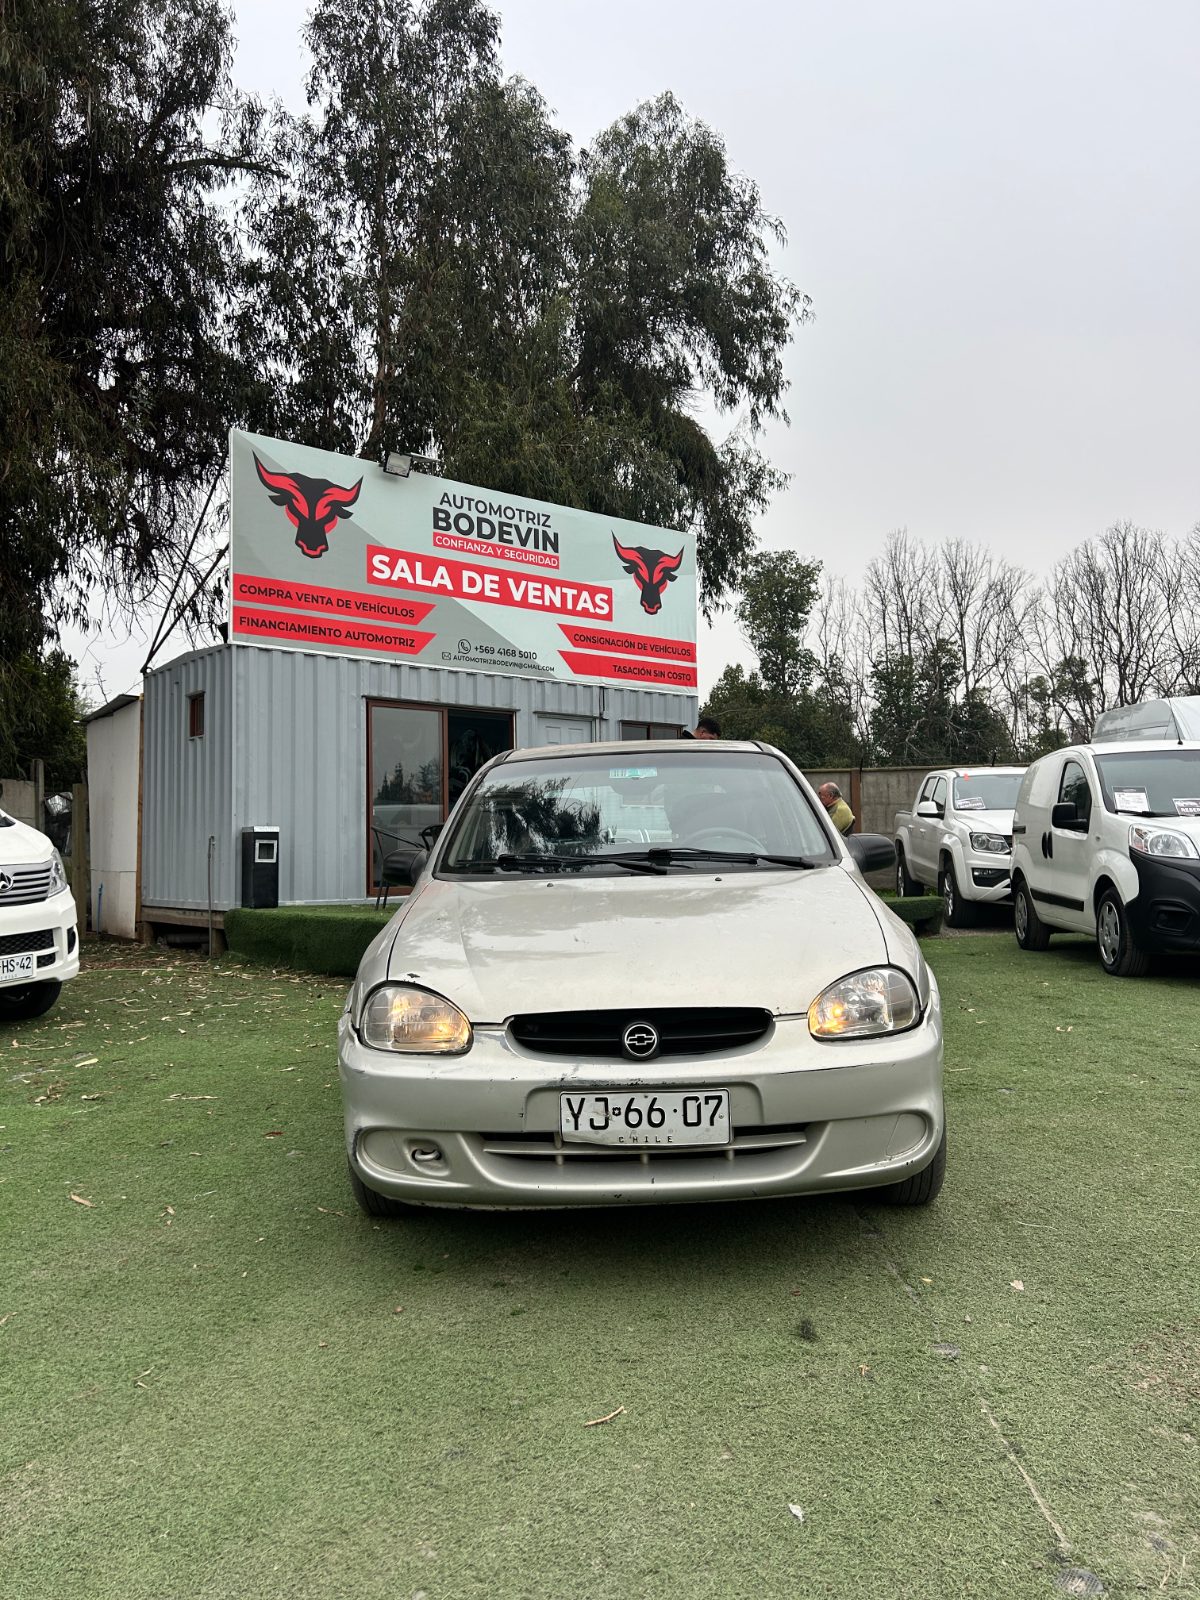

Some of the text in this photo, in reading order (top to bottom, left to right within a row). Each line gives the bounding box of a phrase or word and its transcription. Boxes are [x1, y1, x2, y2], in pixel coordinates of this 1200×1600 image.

[439, 492, 551, 528] AUTOMOTRIZ
[433, 506, 559, 553] BODEVIN
[435, 536, 558, 566] CONFIANZA Y SEGURIDAD
[372, 554, 610, 615] SALA DE VENTAS
[239, 584, 415, 618] COMPRA VENTA DE VEHÍCULOS
[239, 616, 415, 647] FINANCIAMIENTO AUTOMOTRIZ
[573, 633, 691, 656] CONSIGNACIÓN DE VEHÍCULOS
[453, 655, 555, 672] AUTOMOTRIZBODEVIN@GMAIL.COM
[474, 645, 537, 659] +569 4168 5010
[612, 664, 691, 681] TASACIÓN SIN COSTO
[618, 1135, 673, 1143] CHILE
